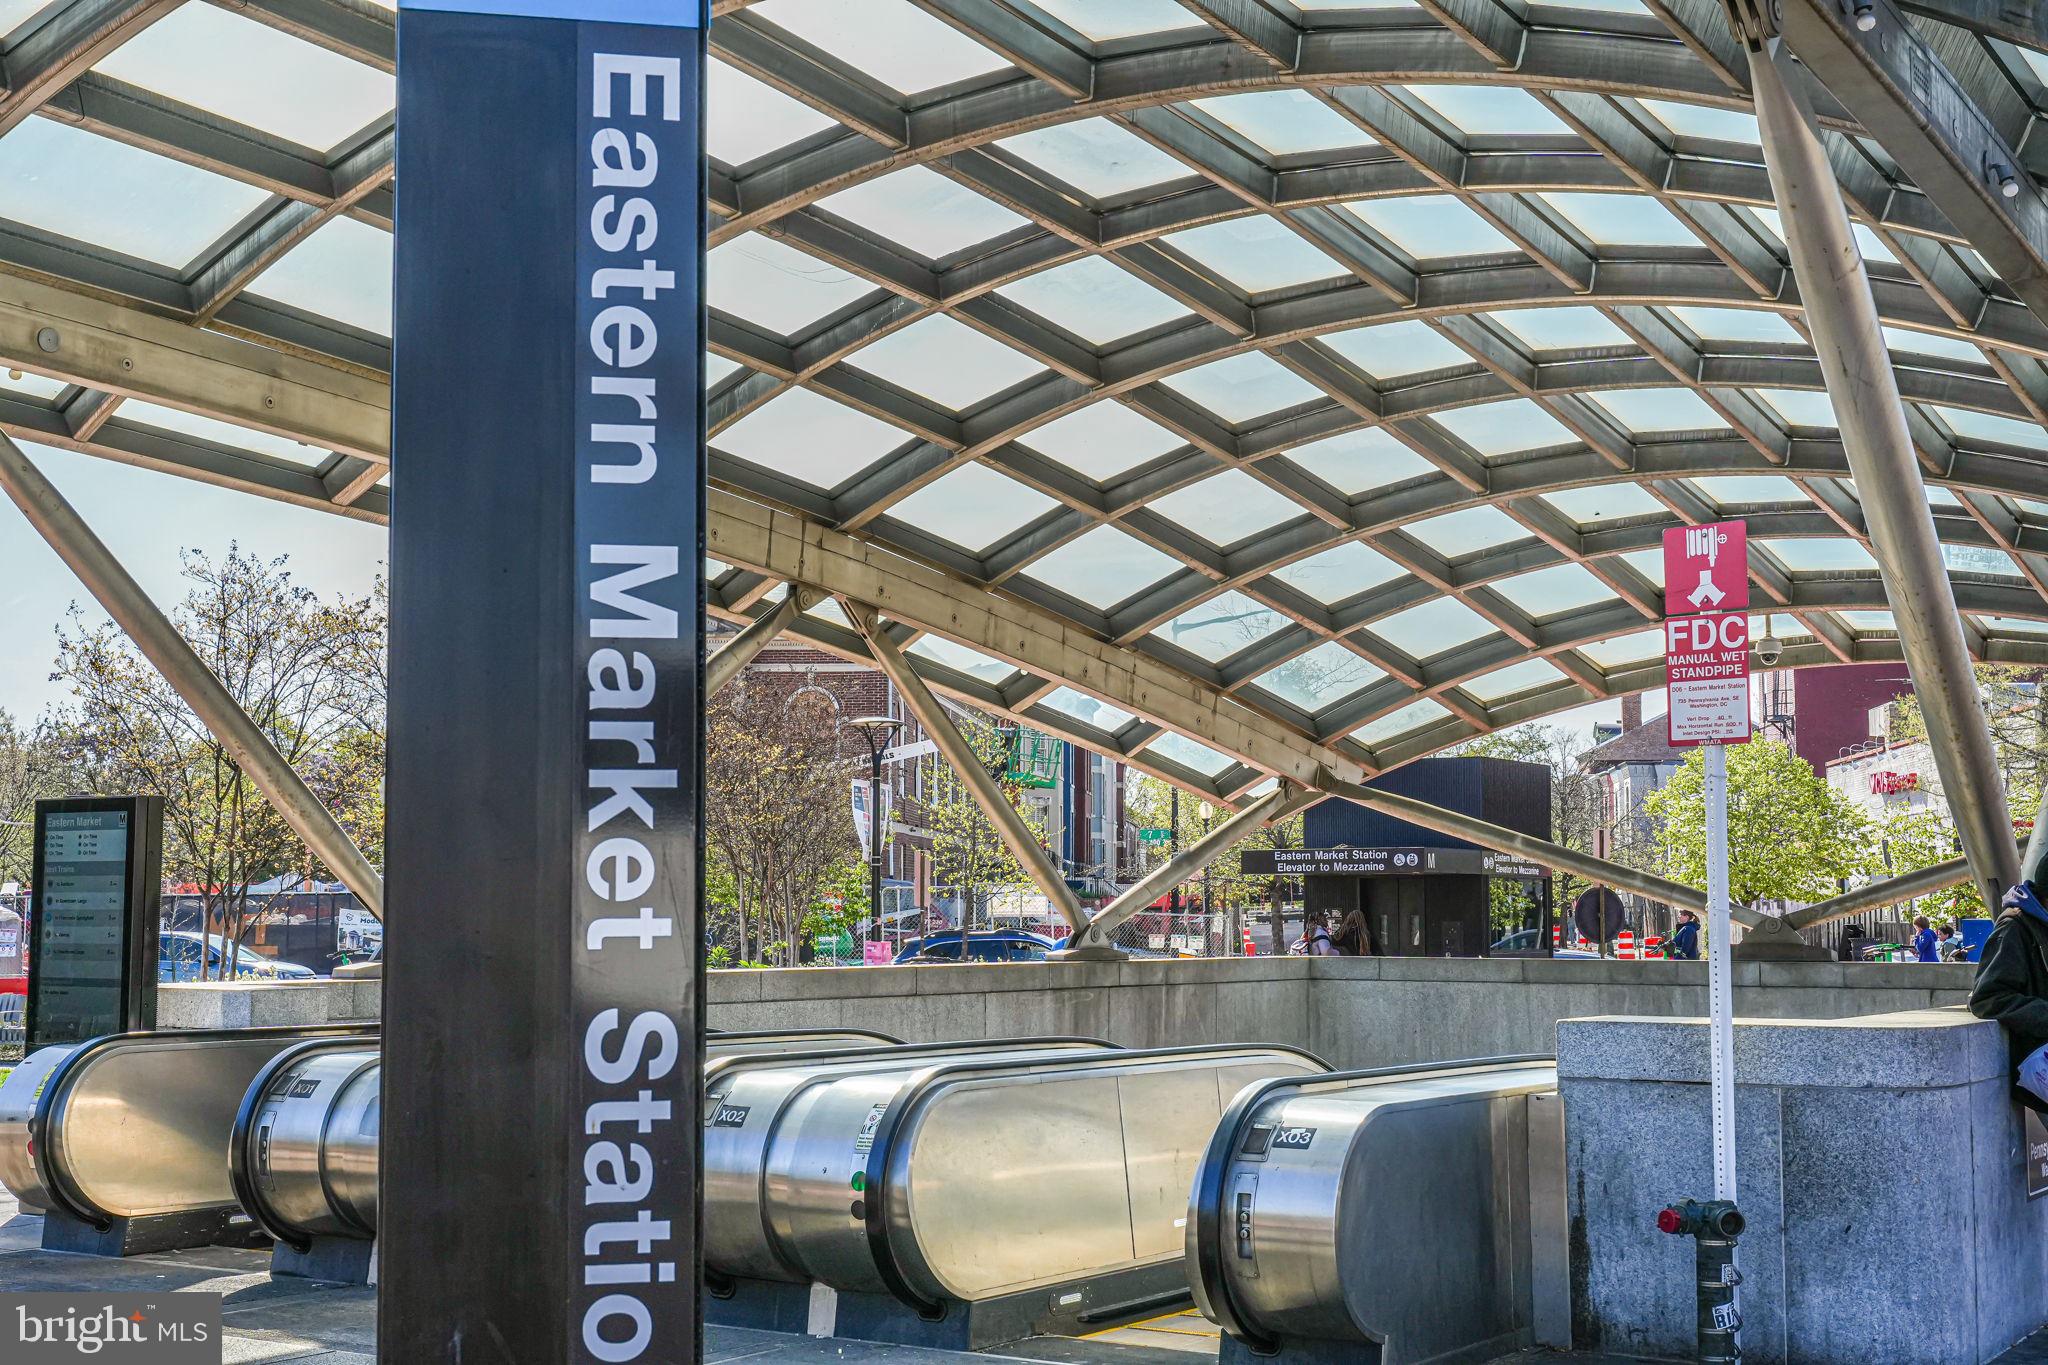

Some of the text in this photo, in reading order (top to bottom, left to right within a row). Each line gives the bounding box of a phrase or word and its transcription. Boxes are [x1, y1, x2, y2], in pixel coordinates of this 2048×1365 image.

[1668, 616, 1745, 652] FDC
[1668, 651, 1747, 665] MANUAL WET
[1672, 664, 1743, 678] STANDPIPE
[581, 52, 681, 1363] Eastern Market Statio
[47, 817, 75, 827] Eastern
[77, 816, 101, 827] Market
[1274, 850, 1388, 860] Eastern Market Station
[1428, 853, 1435, 868] M
[1494, 853, 1510, 862] Eastern
[1277, 862, 1385, 872] Elevator to Mezzanine
[1496, 865, 1539, 875] Elevator to Mezzanine
